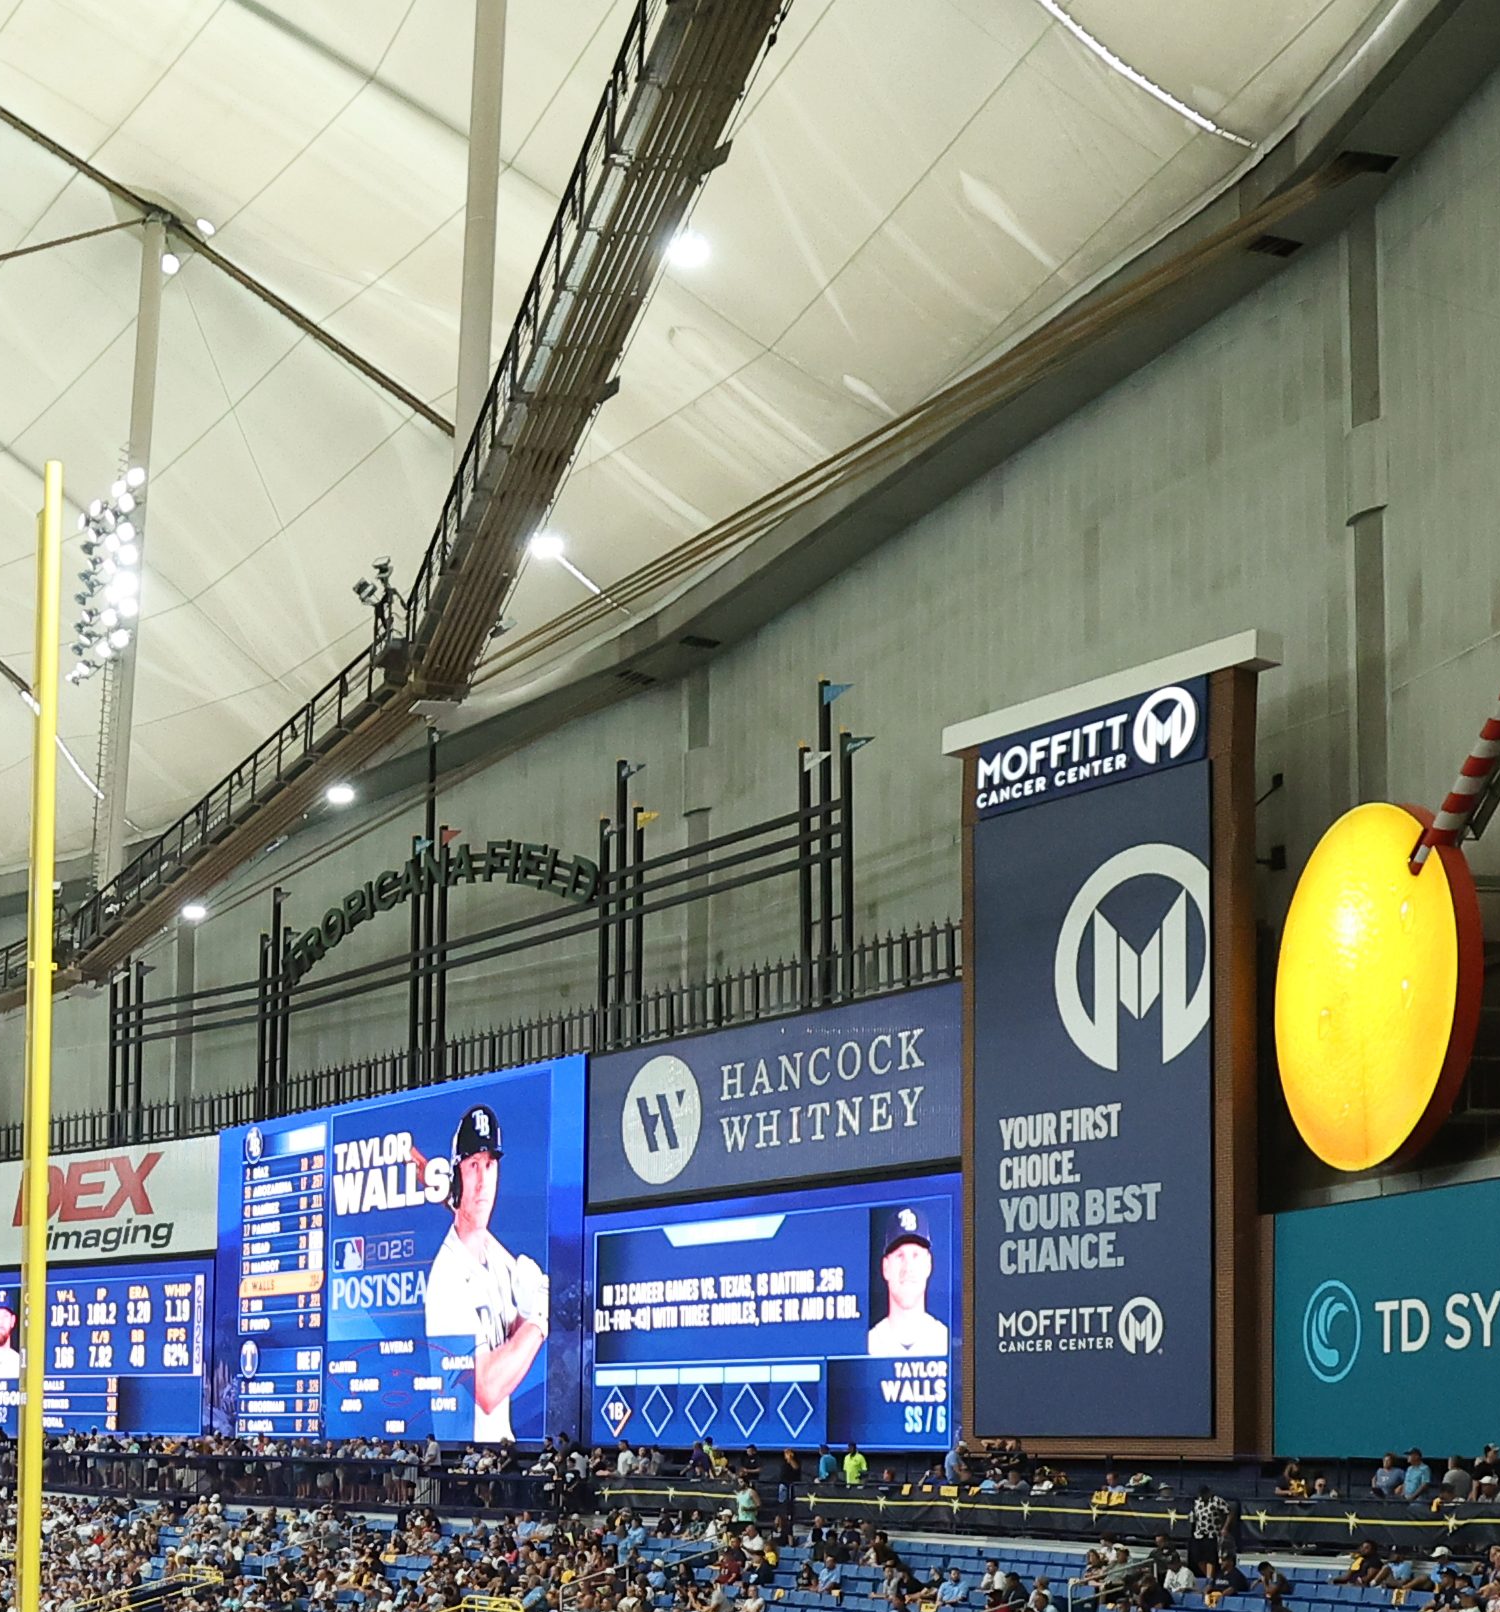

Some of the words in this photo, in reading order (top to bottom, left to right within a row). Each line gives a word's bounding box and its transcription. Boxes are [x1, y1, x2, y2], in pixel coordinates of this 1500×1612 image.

[976, 713, 1129, 790] MOFFITT
[976, 776, 1047, 809] CANCER
[1054, 752, 1128, 788] CENTER
[282, 843, 476, 988] TROPICANA
[482, 839, 601, 902] FIELD
[720, 1027, 926, 1101] HANCOCK
[720, 1086, 926, 1153] WHITNEY
[999, 1111, 1057, 1151] YOUR
[1060, 1102, 1122, 1145] FIRST
[334, 1131, 412, 1173] TAYLOR
[999, 1149, 1081, 1191] CHOICE.
[333, 1156, 452, 1217] WALLS
[999, 1190, 1081, 1234] YOUR
[1084, 1182, 1162, 1228] BEST
[45, 1218, 174, 1253] imaging
[365, 1239, 414, 1261] 2023
[999, 1231, 1125, 1276] CHANCE.
[129, 1285, 149, 1299] ERA
[164, 1282, 192, 1297] WHIP
[629, 1282, 664, 1305] CAREER
[665, 1278, 699, 1303] GAMES
[719, 1274, 756, 1300] TEXAS,
[769, 1269, 814, 1295] BATTING
[653, 1304, 678, 1328] WITH
[679, 1302, 710, 1326] THREE
[801, 1297, 824, 1321] AND
[998, 1306, 1114, 1338] MOFFITT
[1374, 1297, 1430, 1356] TD
[61, 1331, 69, 1345] K
[998, 1339, 1053, 1354] CANCER
[1058, 1337, 1114, 1352] CENTER
[894, 1361, 947, 1378] TAYLOR
[881, 1378, 947, 1403] WALLS
[608, 1401, 624, 1421] 1B
[904, 1406, 922, 1433] SS
[935, 1405, 946, 1432] 6
